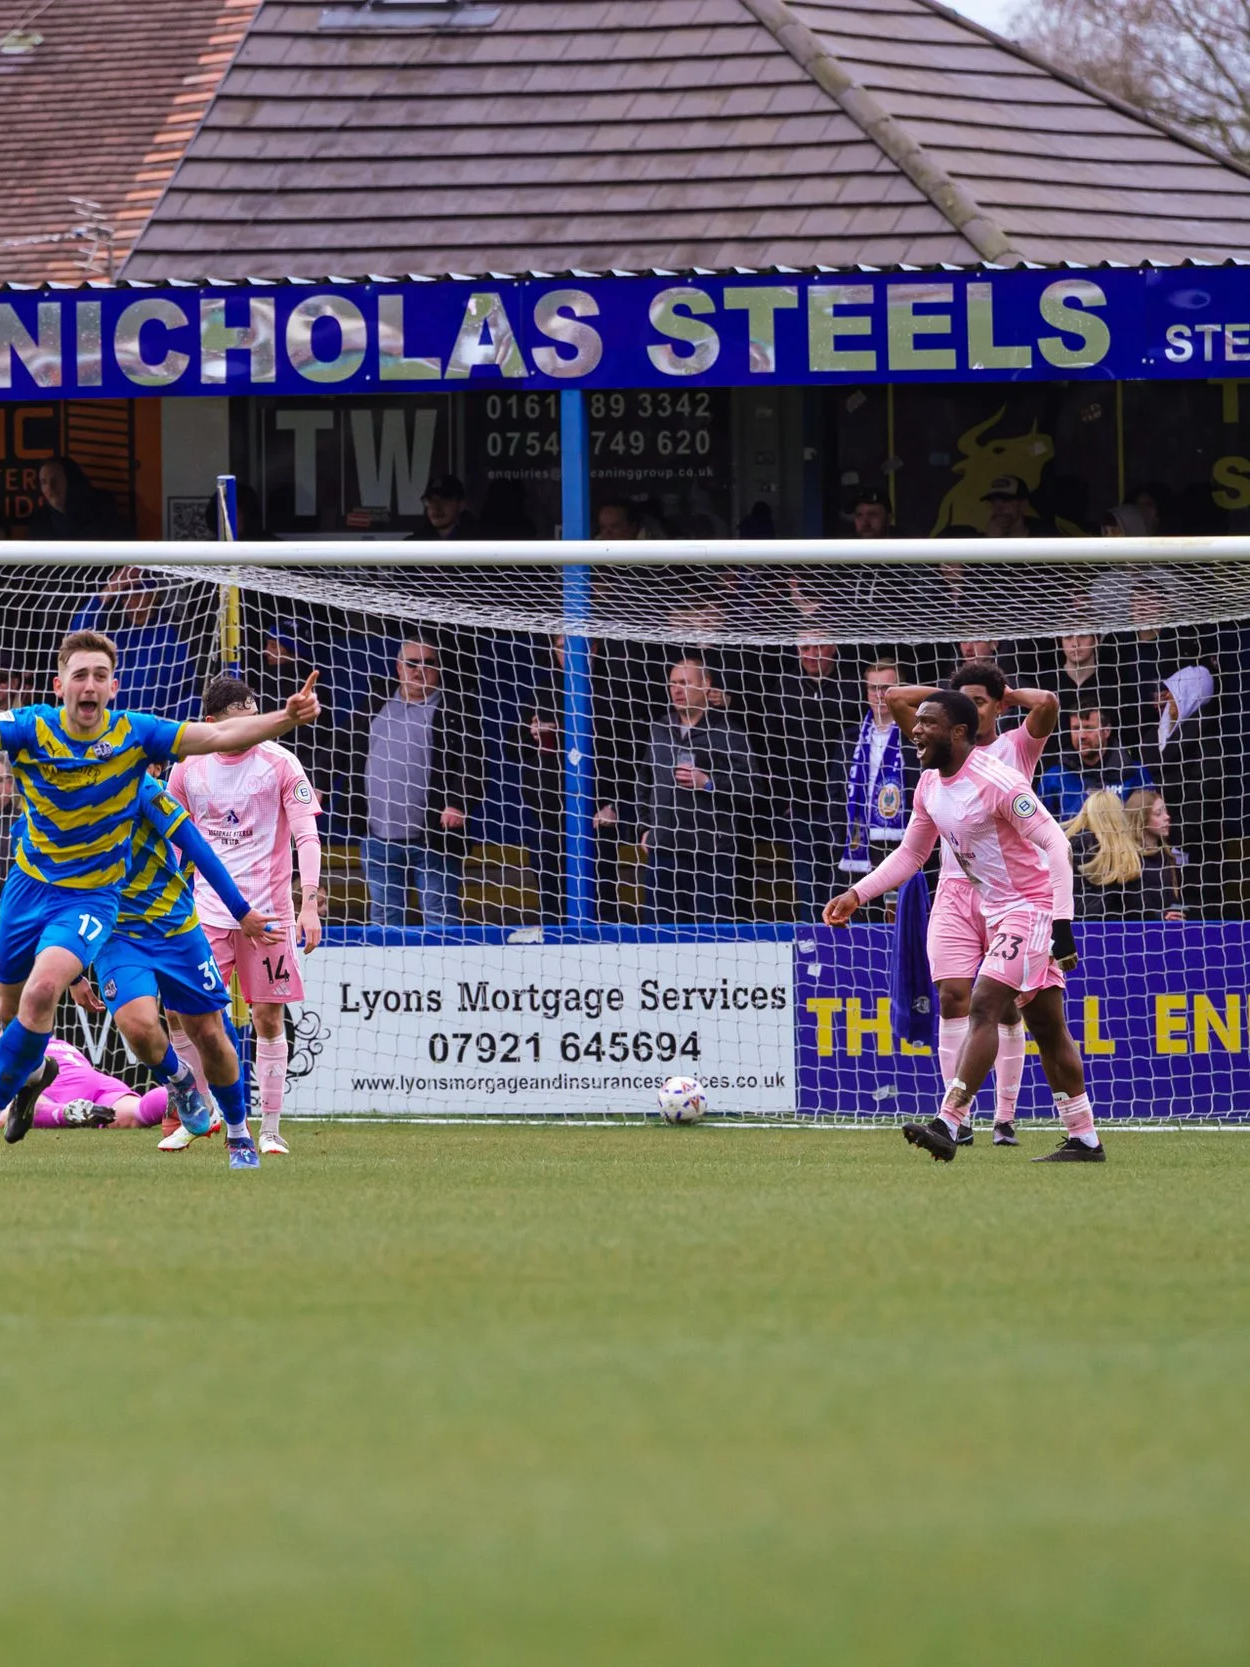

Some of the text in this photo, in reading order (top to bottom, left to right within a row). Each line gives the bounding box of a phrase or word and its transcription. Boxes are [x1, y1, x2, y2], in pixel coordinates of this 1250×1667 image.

[647, 279, 1111, 377] STEELS
[638, 392, 711, 417] 3342
[590, 432, 645, 455] 749
[656, 431, 711, 454] 620
[78, 913, 103, 942] 17
[989, 932, 1024, 961] 23
[261, 954, 291, 984] 14
[340, 978, 787, 1020] Lyons Mortgage Services
[1155, 994, 1250, 1054] EN
[428, 1030, 701, 1064] 07921 645694
